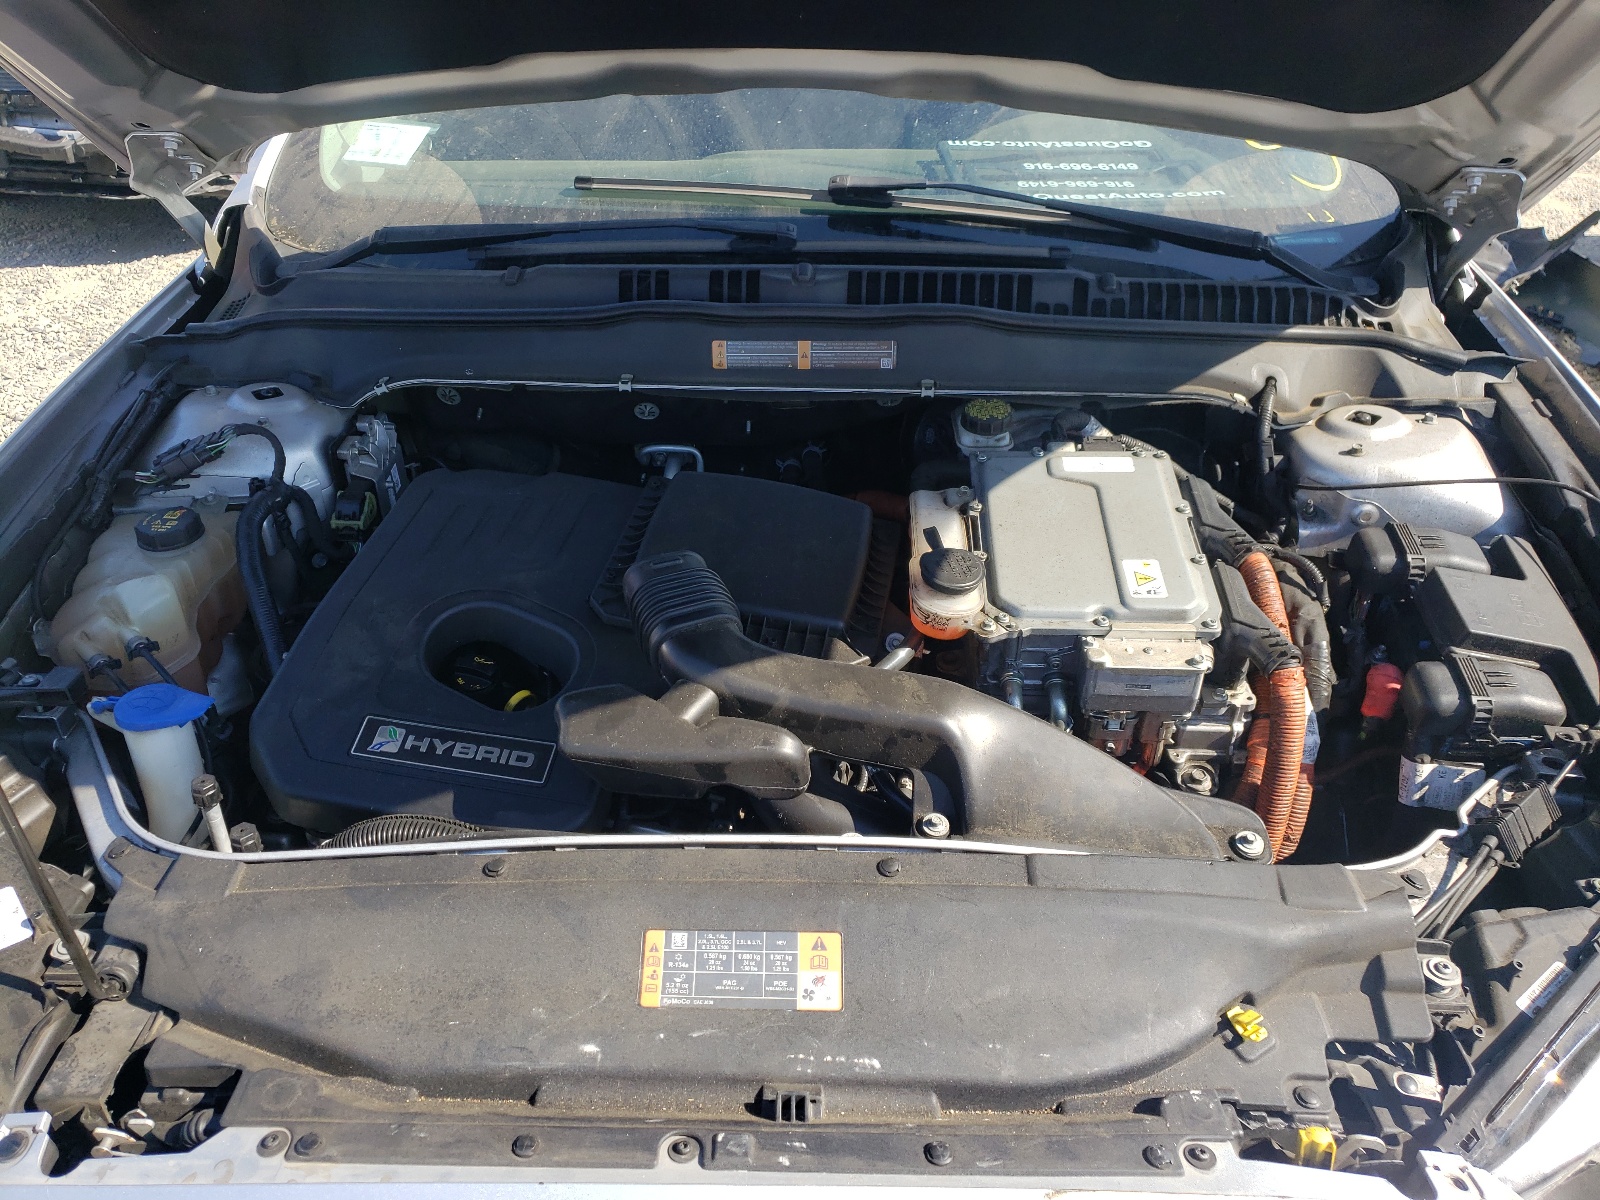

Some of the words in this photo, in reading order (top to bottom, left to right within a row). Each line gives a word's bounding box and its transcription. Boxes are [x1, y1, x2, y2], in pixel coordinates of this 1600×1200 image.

[947, 140, 1152, 149] GoQuestAuto.com
[1023, 162, 1139, 171] 916-696-6149
[1017, 180, 1135, 188] 916-696-6149
[1029, 188, 1226, 200] QuestAuto.com
[404, 734, 536, 768] HYBRID
